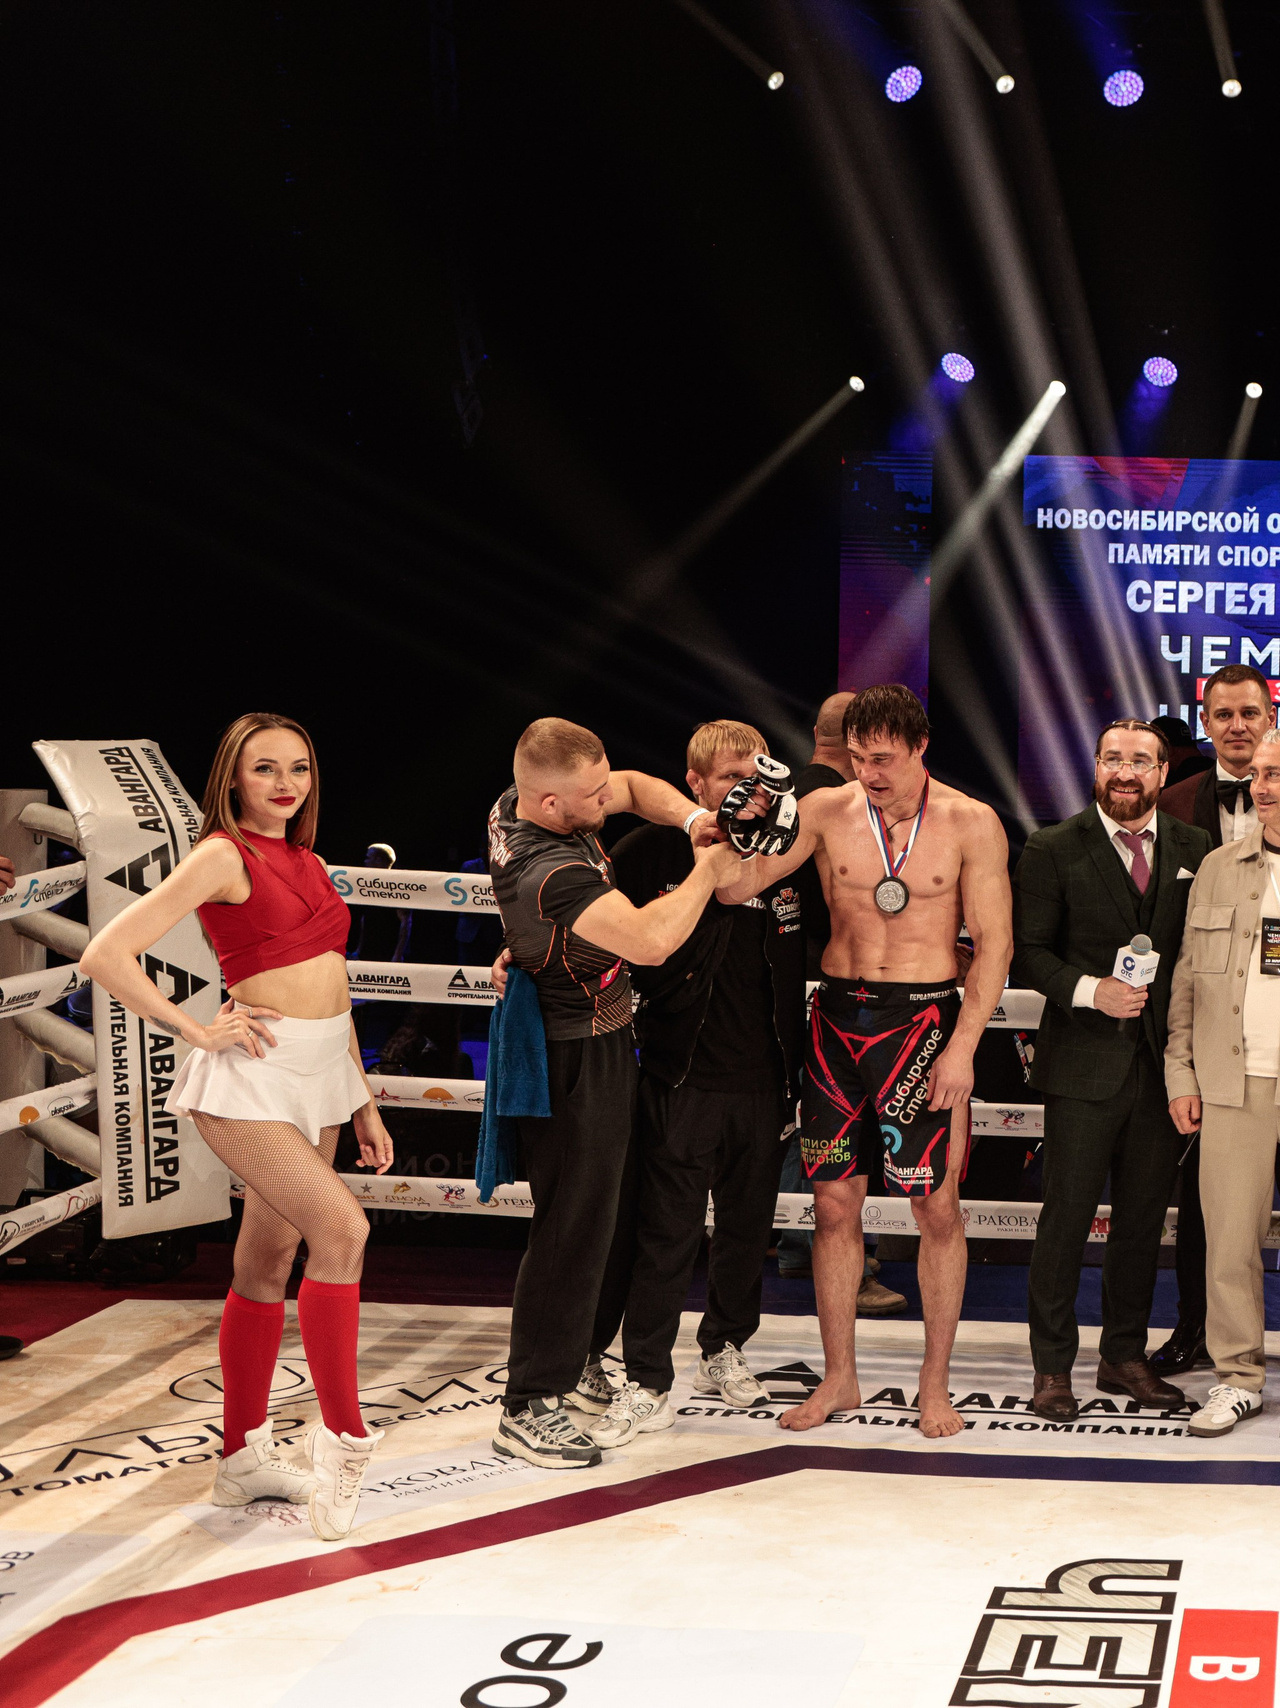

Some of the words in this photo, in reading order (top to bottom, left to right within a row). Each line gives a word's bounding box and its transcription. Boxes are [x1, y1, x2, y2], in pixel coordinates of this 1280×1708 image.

[1036, 506, 1259, 533] НОВОСИБИРСКОЙ
[1108, 543, 1210, 566] ПАМЯТИ
[1126, 579, 1275, 615] СЕРГЕЯ
[140, 747, 182, 797] КОМПАНИЯ
[98, 746, 166, 834] АВАНГАРД
[356, 878, 427, 893] Сибирское
[359, 888, 411, 901] Стекло
[348, 986, 376, 994] ТЕЛЬНАЯ
[376, 988, 412, 996] КОМПАНИЯ
[355, 973, 411, 987] АВАНГАРД
[447, 992, 494, 1000] СТРОИТЕЛЬНАЯ
[109, 992, 130, 1096] ИТЕЛЬНАЯ
[885, 1028, 943, 1117] Сибирское
[114, 1101, 134, 1207] КОМПАНИЯ
[977, 1214, 1038, 1227] РАКОВА
[987, 1421, 1195, 1438] КОМПАНИ
[359, 1454, 517, 1498] АКОВАР
[392, 1483, 438, 1498] РАКИ
